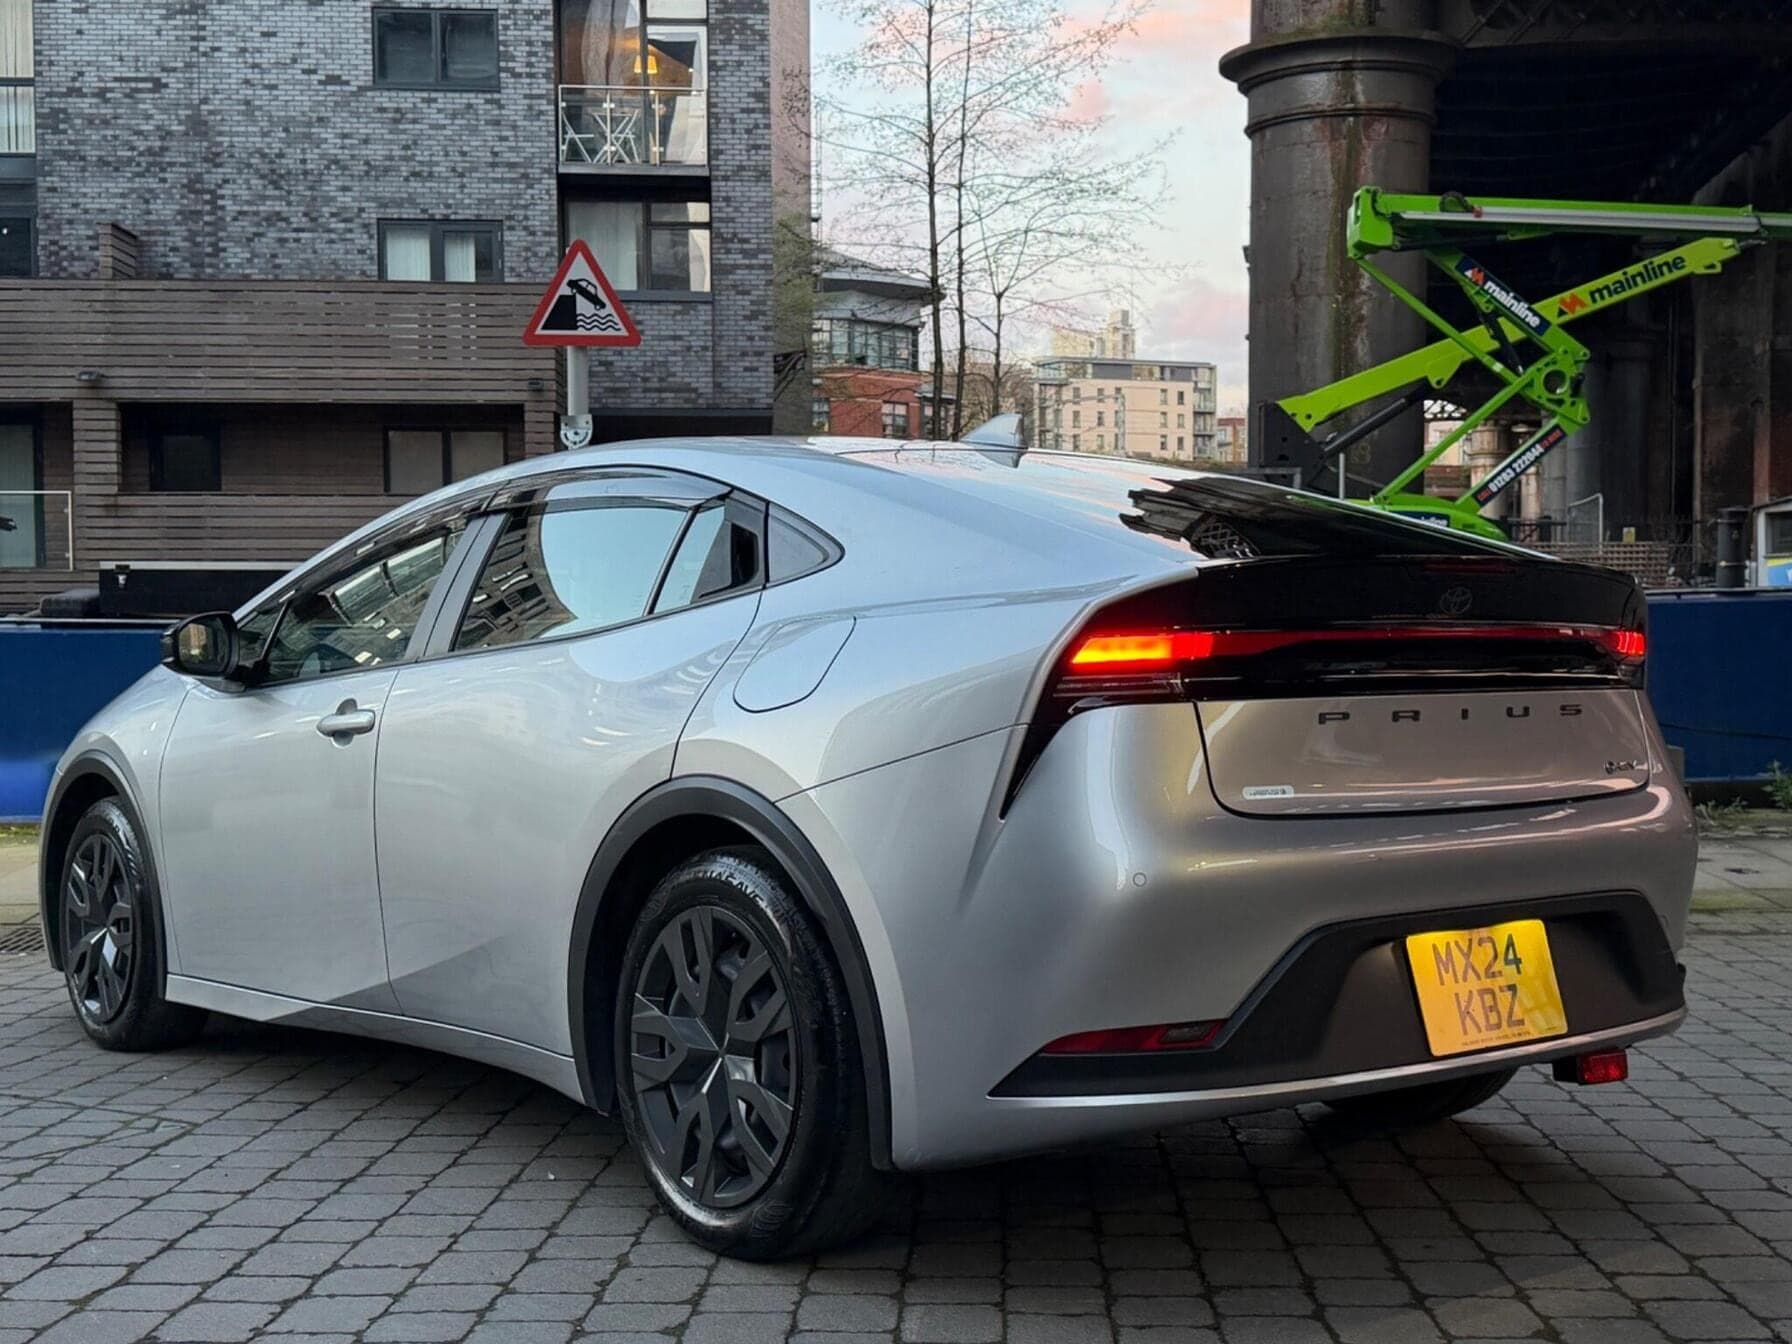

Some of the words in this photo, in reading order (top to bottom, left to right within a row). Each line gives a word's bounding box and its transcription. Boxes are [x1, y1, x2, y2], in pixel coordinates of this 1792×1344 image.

[1589, 256, 1686, 303] mainline
[1484, 281, 1540, 327] mainline
[1318, 704, 1582, 725] PRIUS
[1432, 933, 1522, 986] MX24
[1455, 983, 1525, 1036] KBZ
